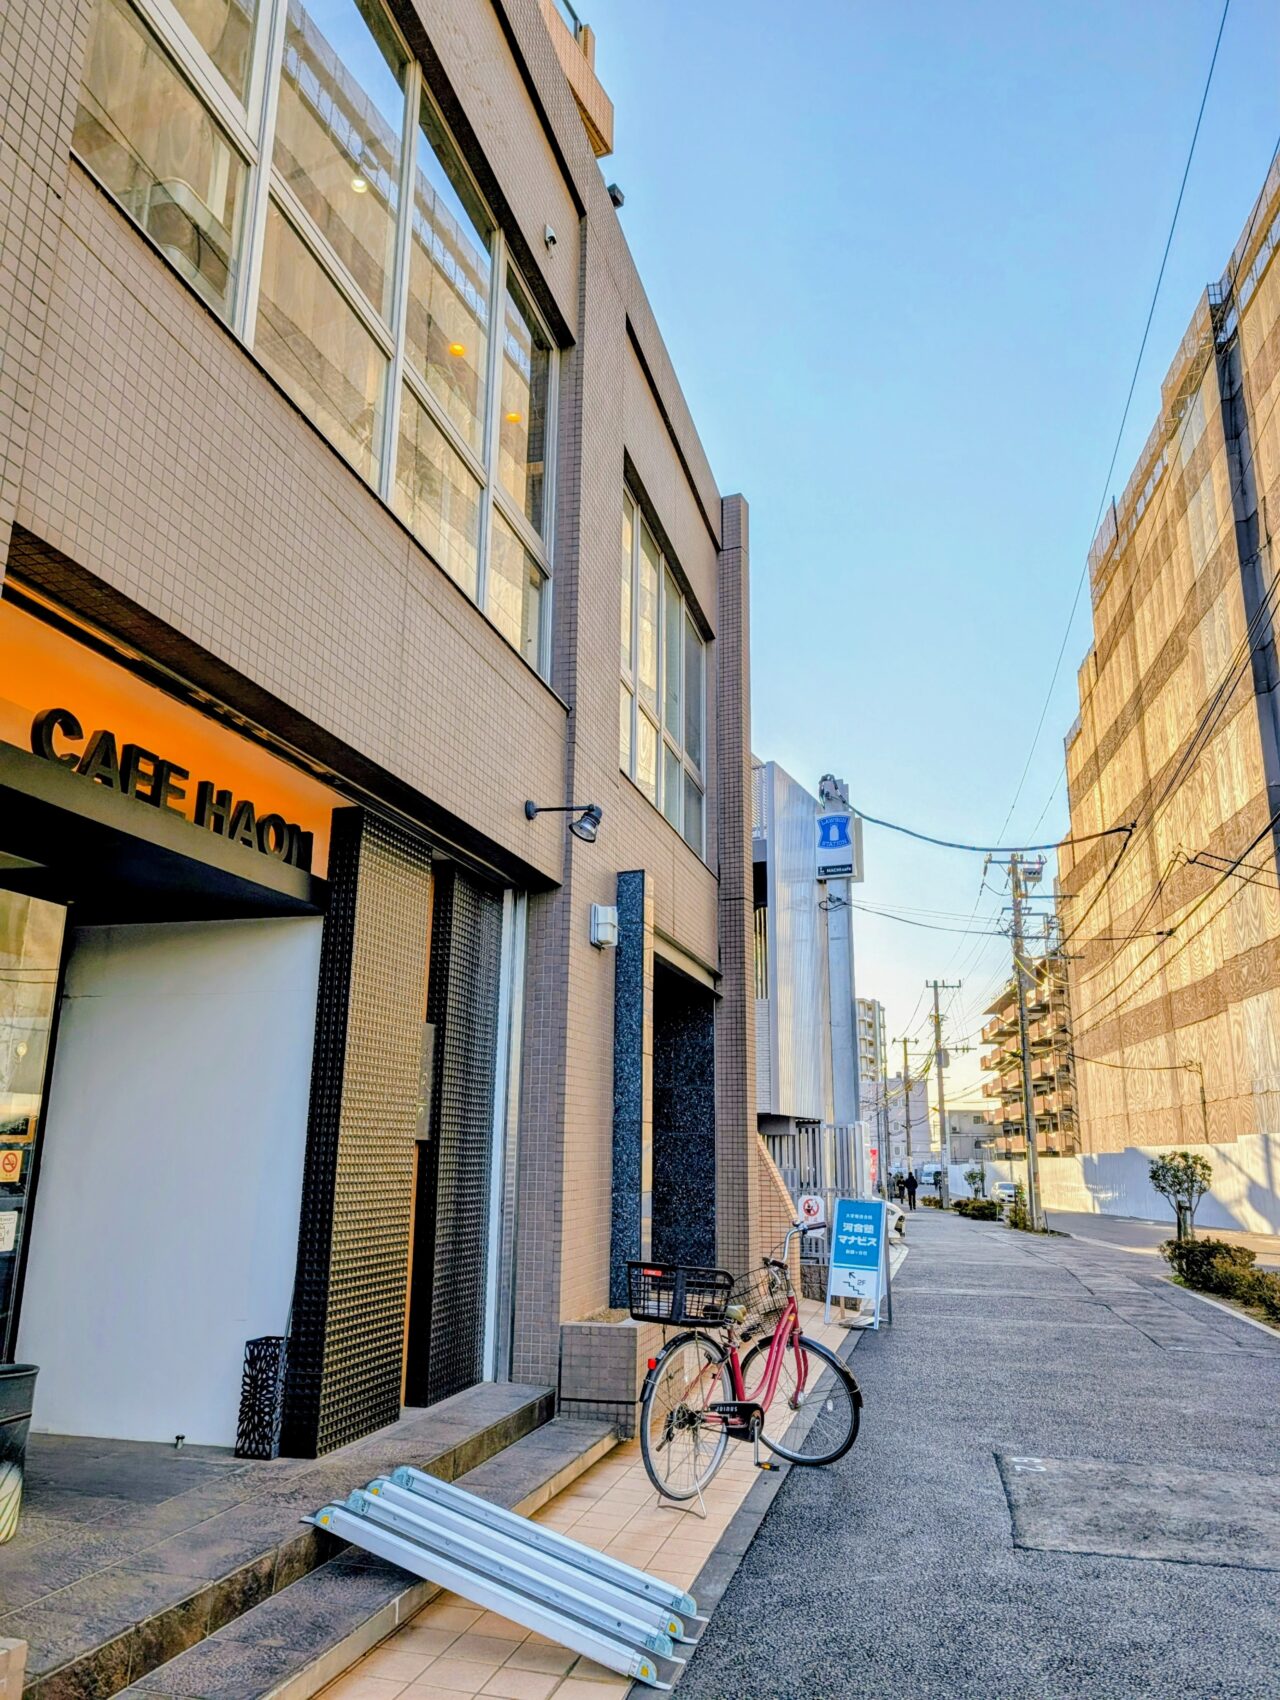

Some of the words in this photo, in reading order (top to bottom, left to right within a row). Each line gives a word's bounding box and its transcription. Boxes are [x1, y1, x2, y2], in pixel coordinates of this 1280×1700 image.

[31, 708, 189, 819] CAFE
[194, 780, 313, 874] HAON
[838, 1235, 877, 1246] マナビス
